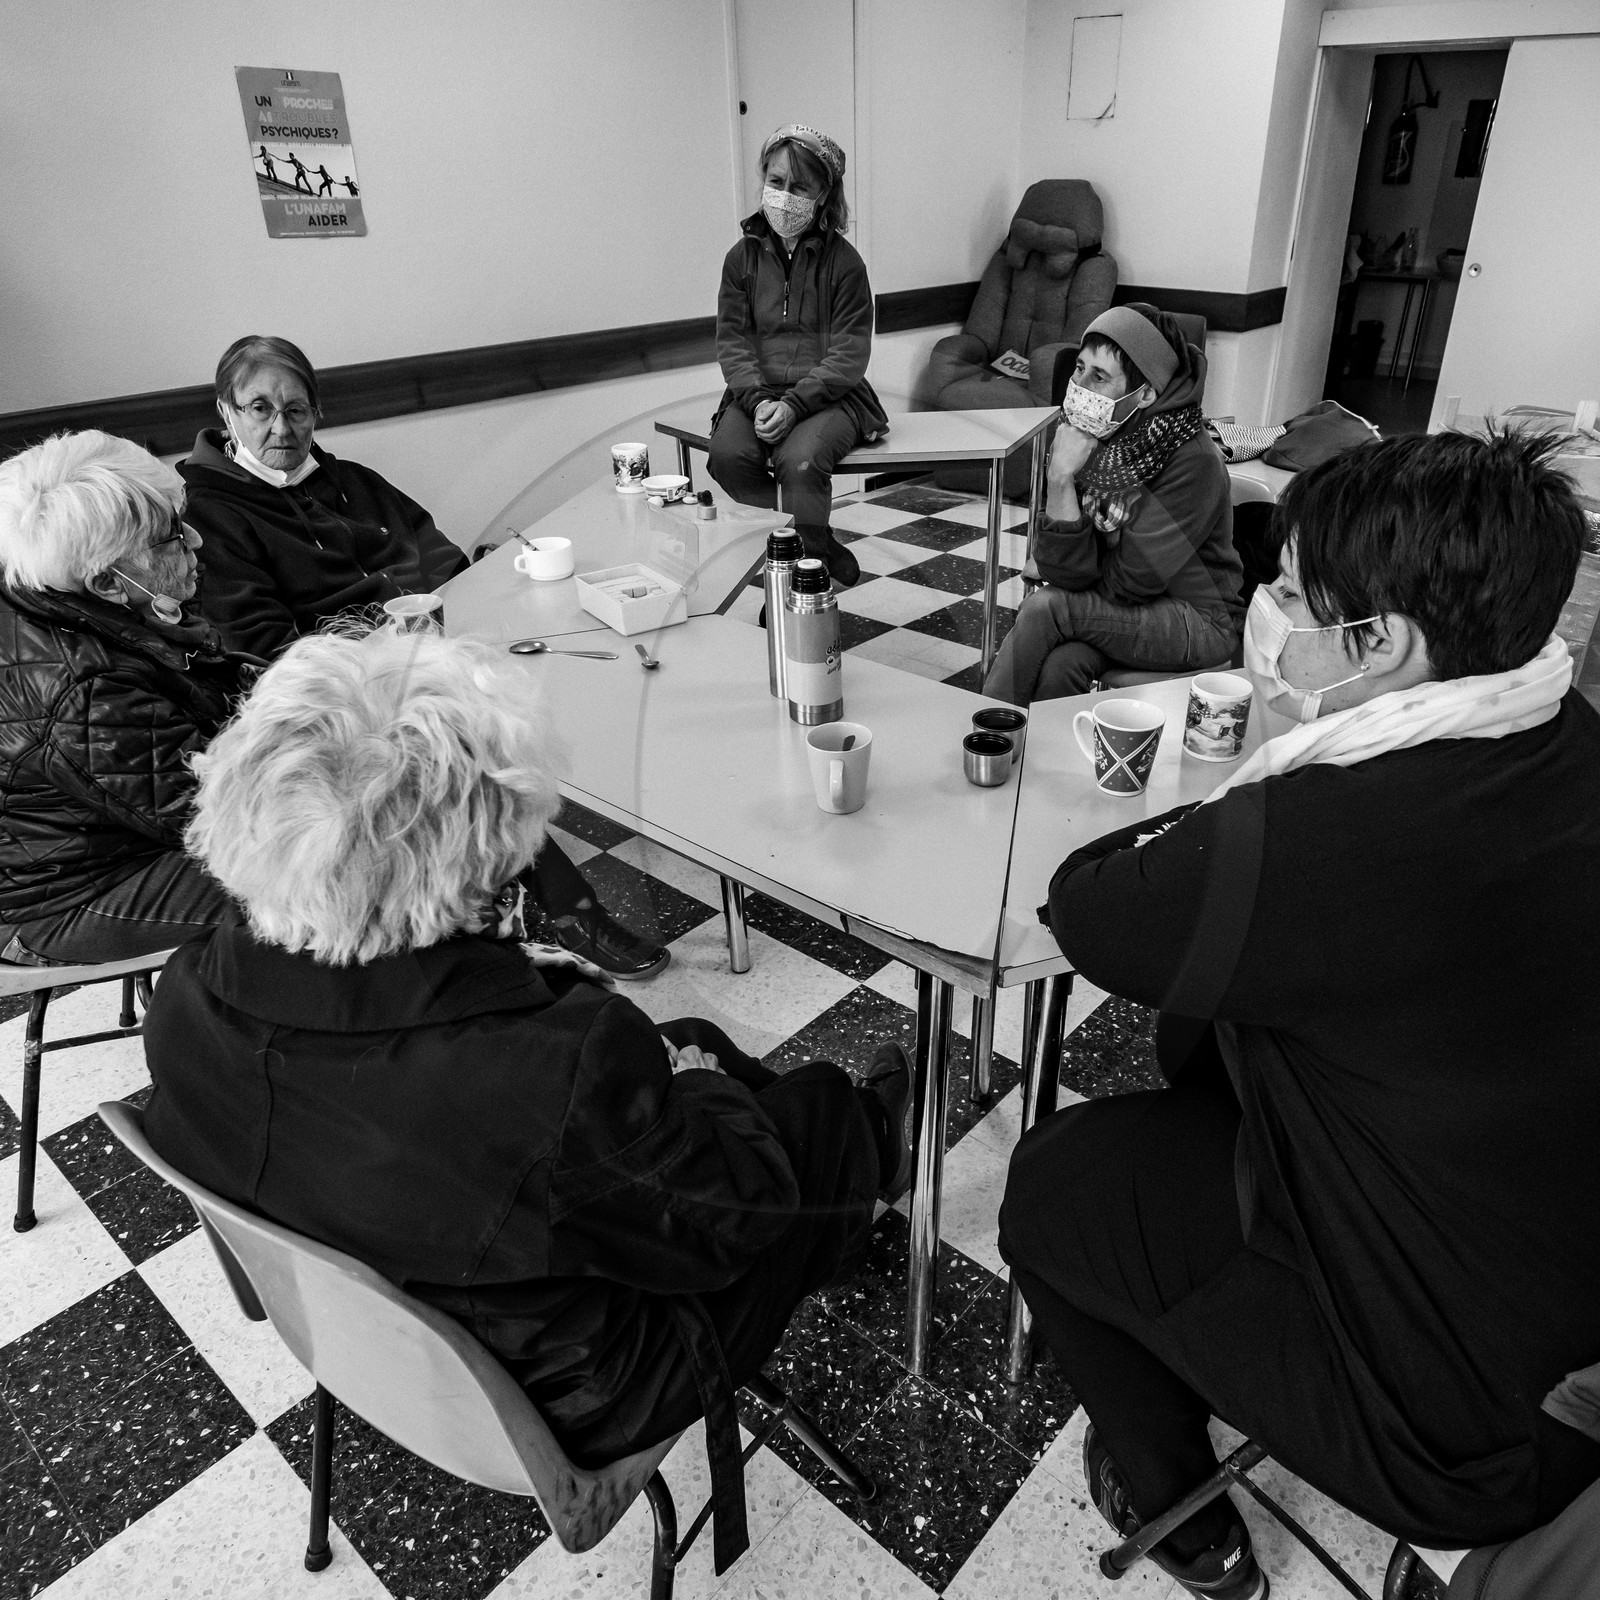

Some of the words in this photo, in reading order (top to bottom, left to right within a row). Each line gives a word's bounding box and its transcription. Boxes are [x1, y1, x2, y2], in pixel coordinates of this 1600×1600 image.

[255, 95, 272, 107] UN
[285, 202, 346, 215] L'UNAFAM
[308, 215, 348, 226] AIDER
[1224, 1546, 1242, 1571] NIKE
